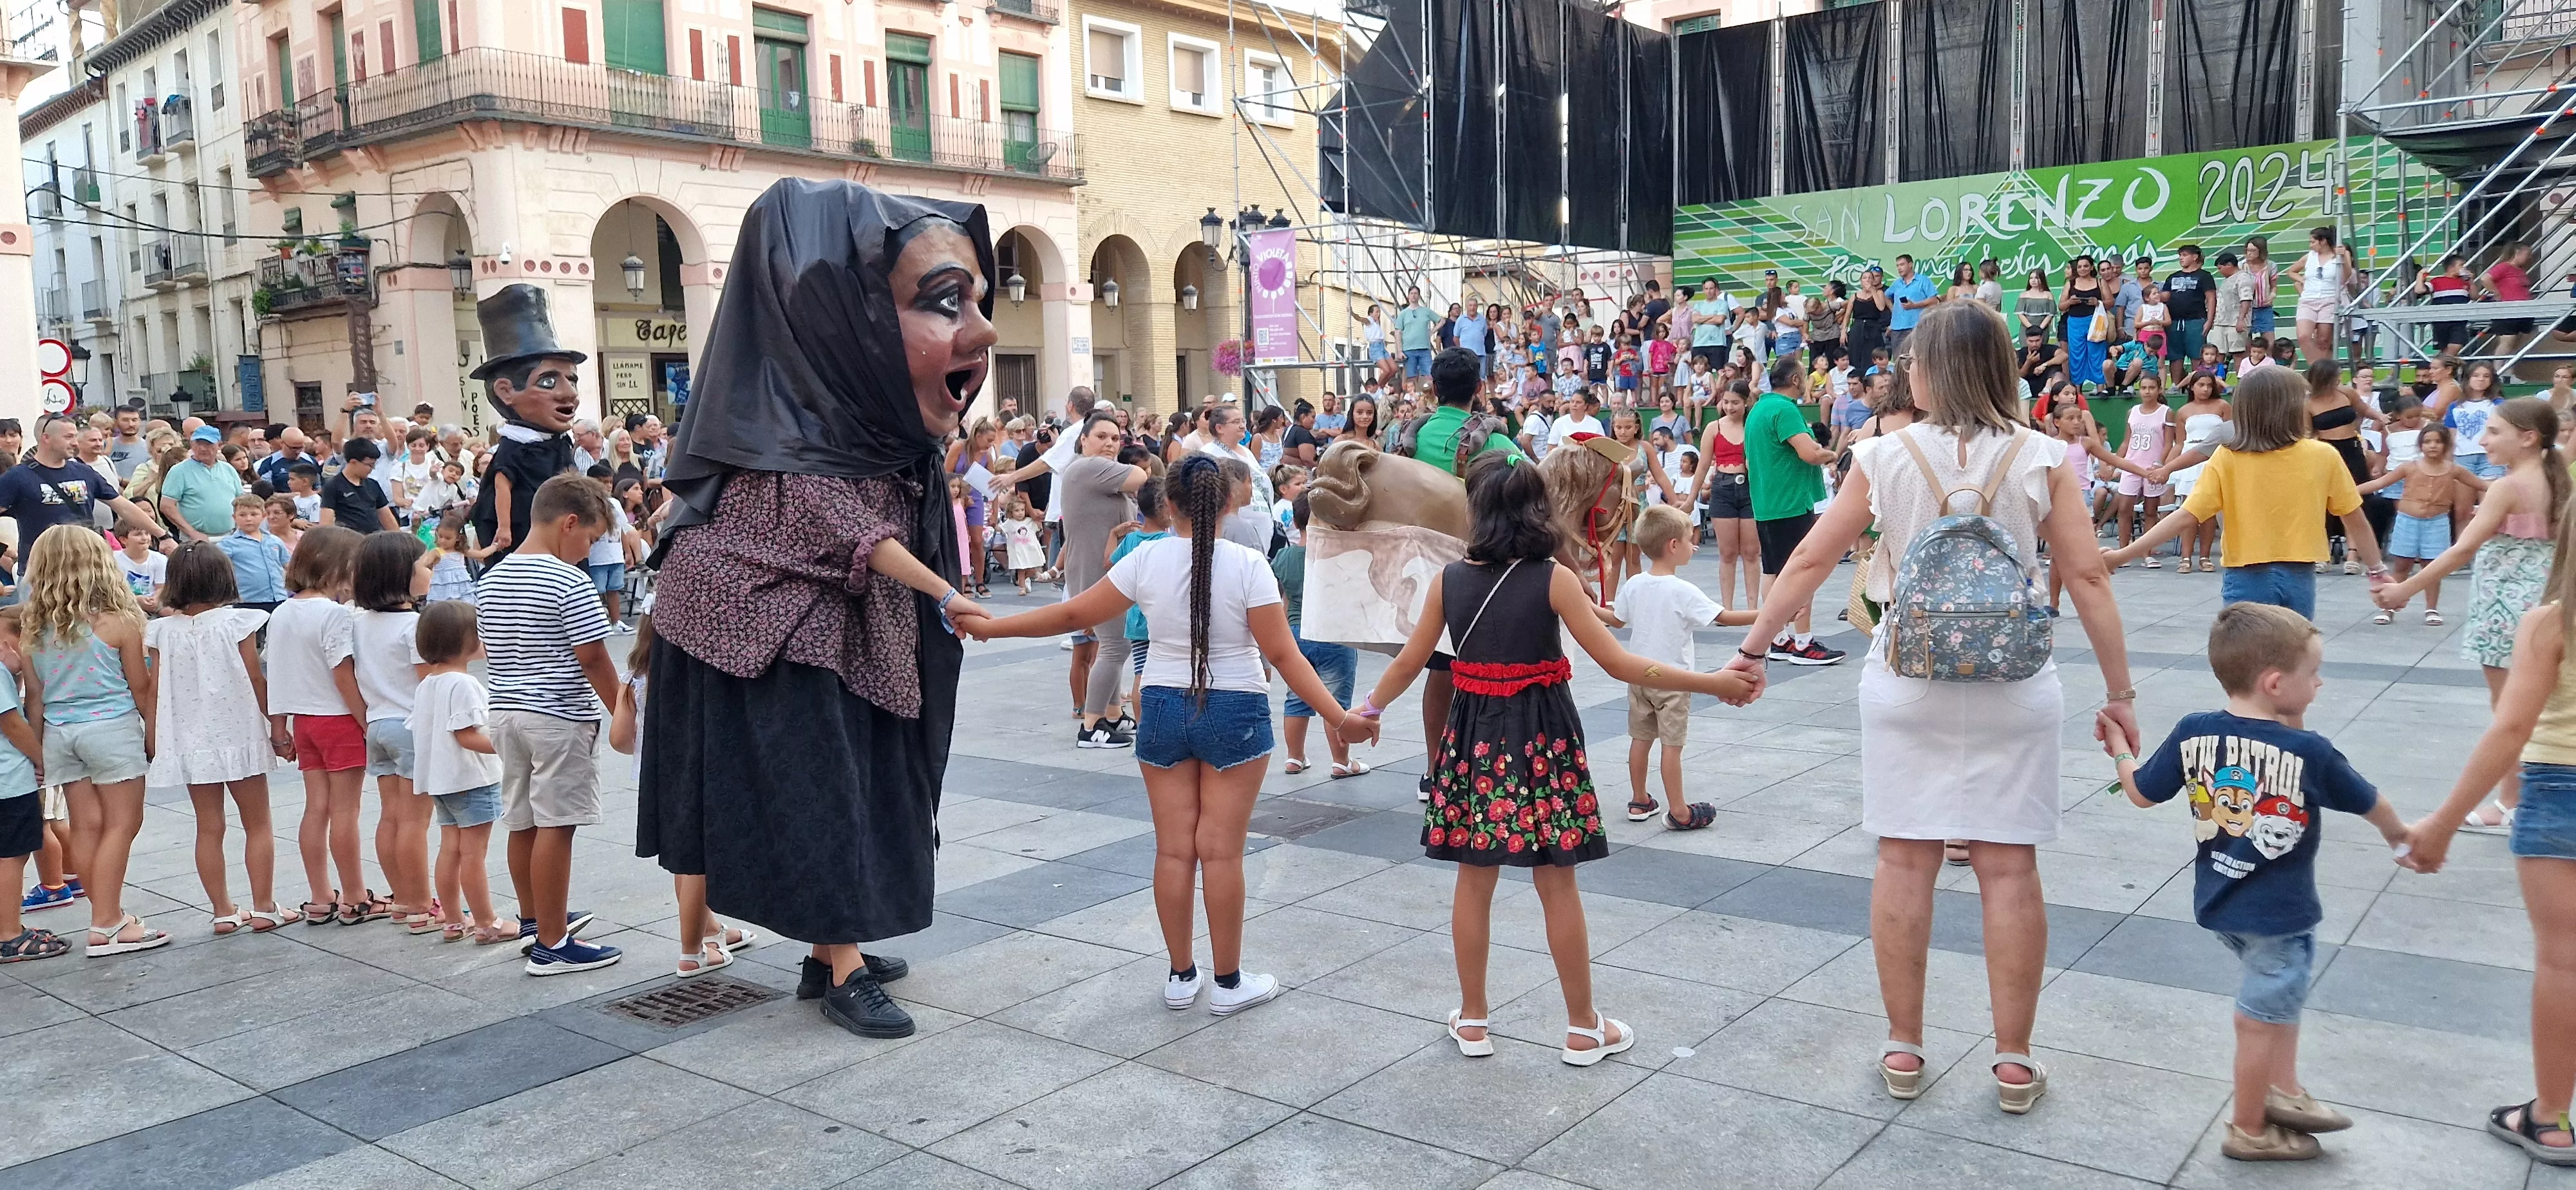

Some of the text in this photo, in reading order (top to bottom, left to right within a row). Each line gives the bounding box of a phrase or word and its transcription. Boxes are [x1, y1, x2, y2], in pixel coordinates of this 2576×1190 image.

[1791, 149, 2334, 243] SAN LORENZO 2024
[1256, 248, 1289, 263] VIOLETA
[1253, 263, 1264, 294] PUNTO
[2130, 433, 2152, 451] 33
[2180, 735, 2304, 808] PAW PATROL
